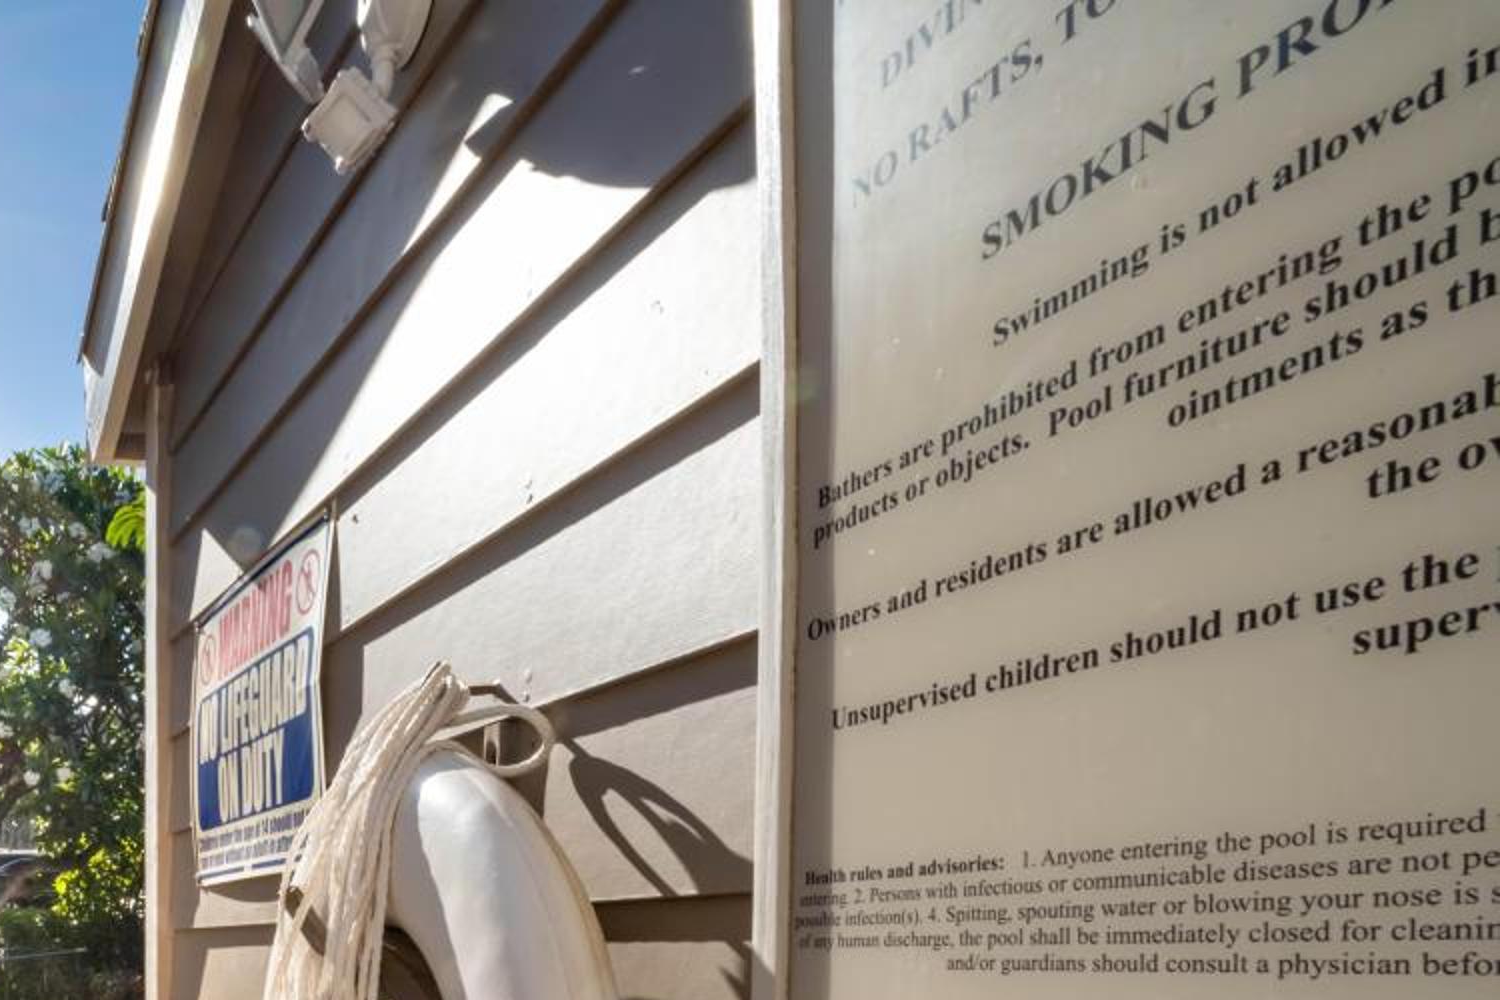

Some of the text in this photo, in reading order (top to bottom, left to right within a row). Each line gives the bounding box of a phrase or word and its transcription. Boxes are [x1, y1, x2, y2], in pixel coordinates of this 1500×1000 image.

[852, 150, 898, 208] NO
[909, 38, 1043, 164] RAFTS,
[980, 0, 1395, 260] SMOKING PRO
[992, 243, 1149, 347] Swimming
[1159, 222, 1186, 254] is
[1198, 177, 1259, 234] not
[1272, 67, 1447, 192] allowed
[813, 491, 899, 548] products
[904, 474, 930, 502] or
[935, 432, 1031, 482] objects.
[1047, 385, 1113, 438] Pool
[1123, 310, 1291, 405] furniture
[1303, 224, 1459, 323] should
[817, 459, 893, 509] Bathers
[899, 440, 934, 470] are
[940, 360, 1078, 456] prohibited
[1088, 323, 1166, 378] from
[1177, 235, 1343, 334] entering
[1358, 193, 1432, 247] the
[1167, 326, 1364, 428] ointments
[1379, 299, 1429, 341] as
[1366, 454, 1441, 499] the
[807, 601, 881, 641] Owners
[886, 580, 928, 614] and
[935, 541, 1048, 598] residents
[1055, 522, 1104, 555] are
[1113, 464, 1246, 535] allowed
[1260, 459, 1283, 485] a
[218, 559, 292, 677] WARNING
[831, 673, 977, 730] Unsupervised
[984, 648, 1100, 693] children
[1109, 609, 1222, 663] should
[1235, 591, 1302, 635] not
[1313, 575, 1386, 614] use
[1400, 551, 1480, 593] the
[218, 727, 284, 823] ON DUTY
[804, 807, 1487, 886] Health rules and advisories: 1. Anyone entering the pool is required
[869, 886, 921, 903] Persons
[925, 882, 958, 899] with
[963, 875, 1043, 897] infectious
[1048, 877, 1067, 892] or
[1072, 863, 1226, 892] communicable
[1233, 860, 1339, 882] diseases
[1347, 855, 1392, 876] are
[1402, 850, 1451, 873] not
[1017, 900, 1094, 924] spouting
[1101, 899, 1156, 918] water
[1163, 899, 1187, 915] or
[1193, 890, 1292, 917] blowing
[1300, 892, 1364, 917] your
[1372, 888, 1442, 908] nose
[1454, 880, 1479, 905] is
[837, 933, 879, 948] human
[959, 929, 983, 947] the
[987, 928, 1024, 951] pool
[1029, 927, 1071, 946] shall
[1077, 926, 1100, 946] be
[1106, 922, 1240, 949] immediately
[1248, 920, 1330, 943] closed
[1341, 919, 1382, 943] for
[947, 953, 996, 971] and/or
[1000, 953, 1086, 975] guardians
[1091, 952, 1158, 973] should
[1165, 952, 1248, 974] consult
[1256, 959, 1269, 974] a
[1278, 951, 1411, 980] physician
